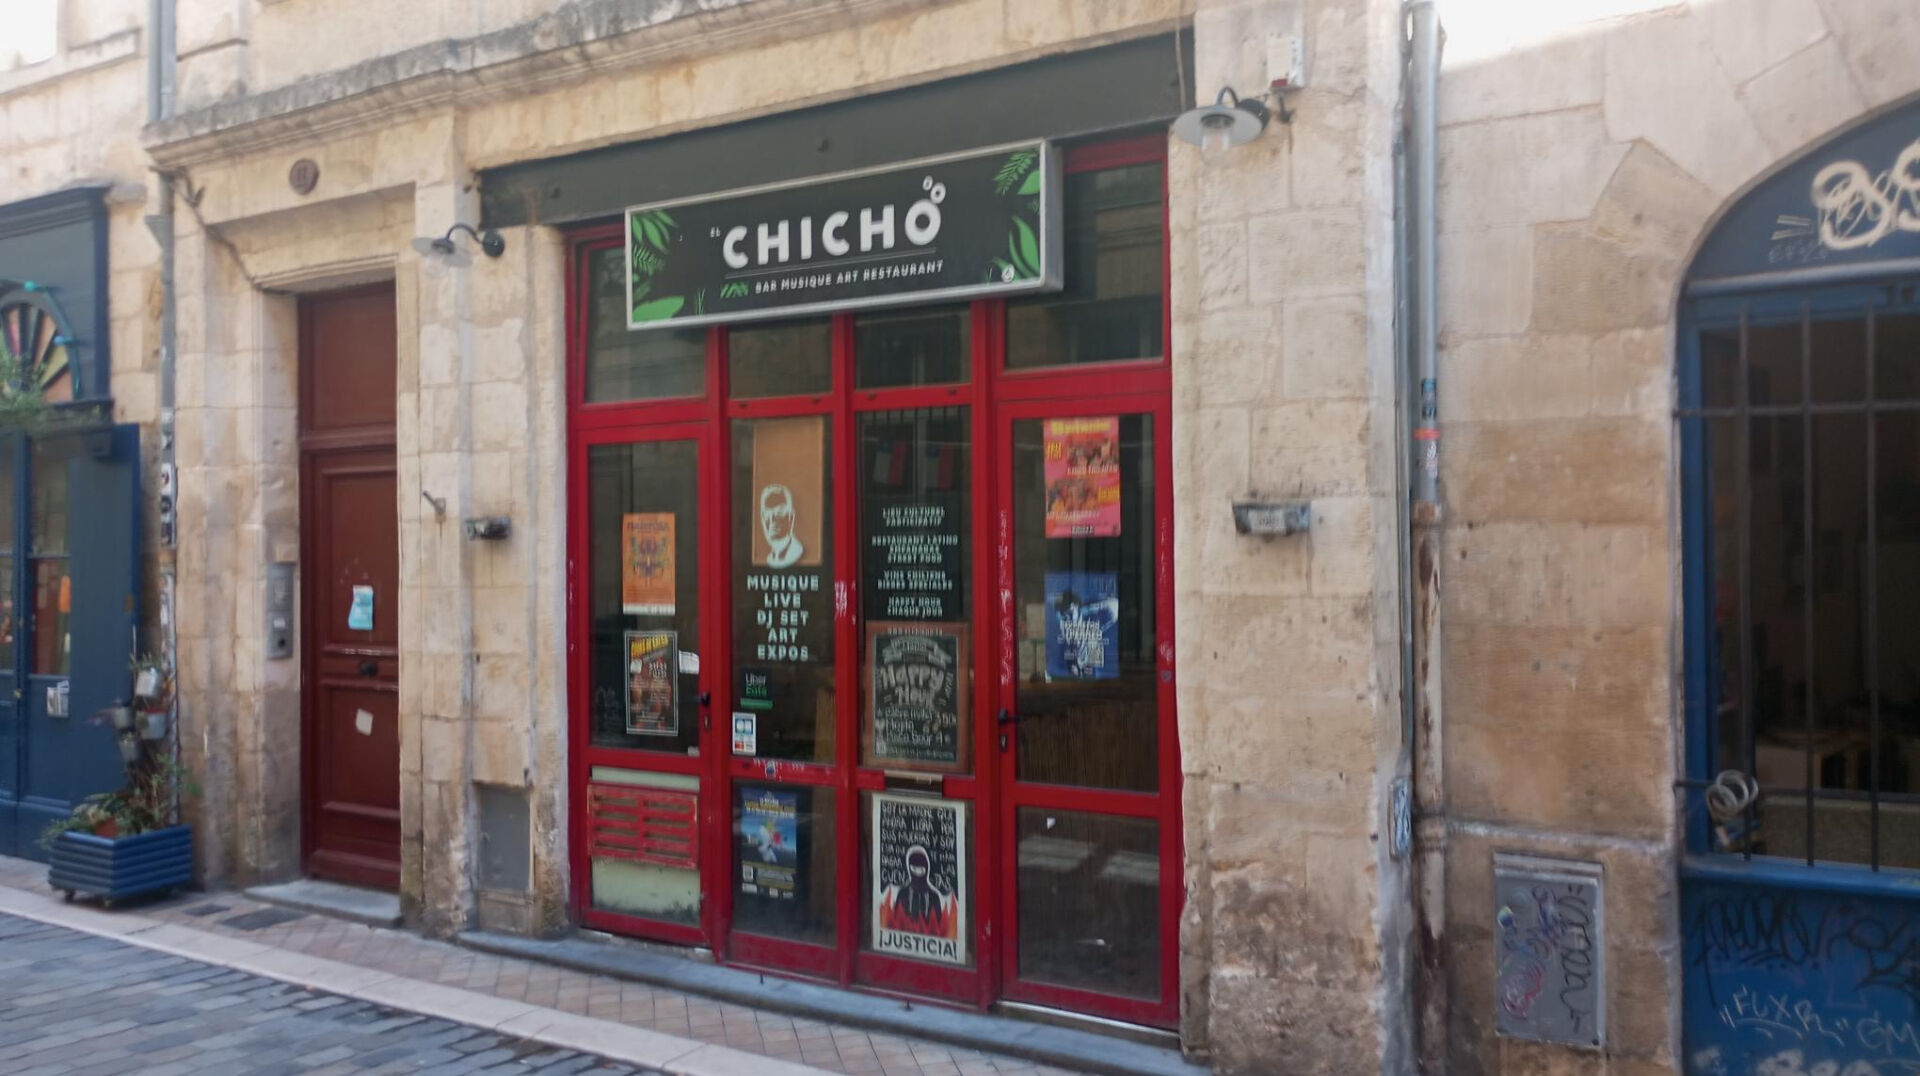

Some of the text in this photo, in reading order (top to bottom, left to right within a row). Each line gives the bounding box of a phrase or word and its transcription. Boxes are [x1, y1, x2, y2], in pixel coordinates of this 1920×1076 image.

[722, 199, 941, 269] CHICHO
[755, 259, 944, 294] BAR MUSIQUE ART RESTAURANT
[872, 535, 925, 547] RESTAURANT
[747, 575, 819, 591] MUSIQUE
[764, 592, 801, 609] LIVE
[888, 597, 941, 608] HAPPY HOUR
[757, 610, 809, 629] DJ SET
[768, 627, 798, 643] ART
[757, 644, 809, 661] EXPOS
[879, 930, 957, 960] ¡JUSTICIA!
